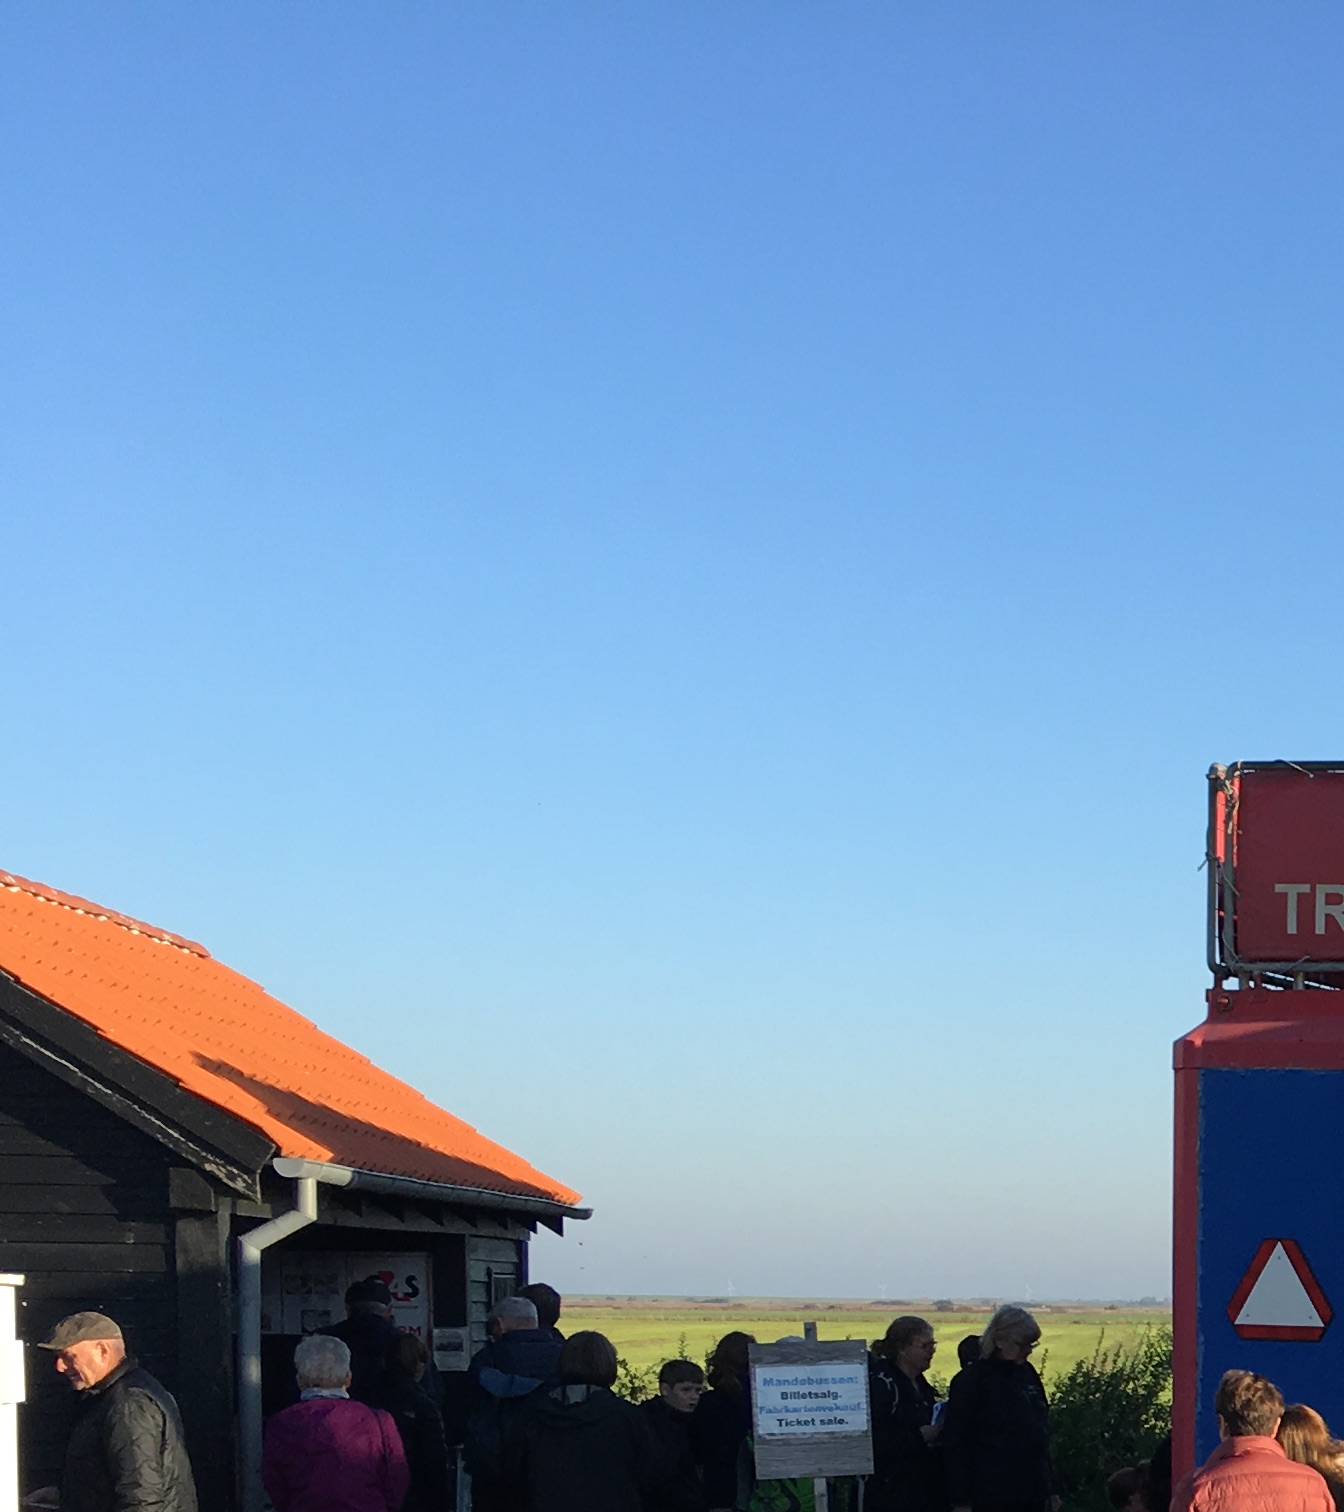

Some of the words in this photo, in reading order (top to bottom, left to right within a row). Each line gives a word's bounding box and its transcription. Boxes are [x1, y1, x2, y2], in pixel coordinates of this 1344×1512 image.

[780, 1390, 842, 1401] Billetsalg.
[776, 1417, 816, 1428] Ticket
[819, 1416, 849, 1426] sale.
